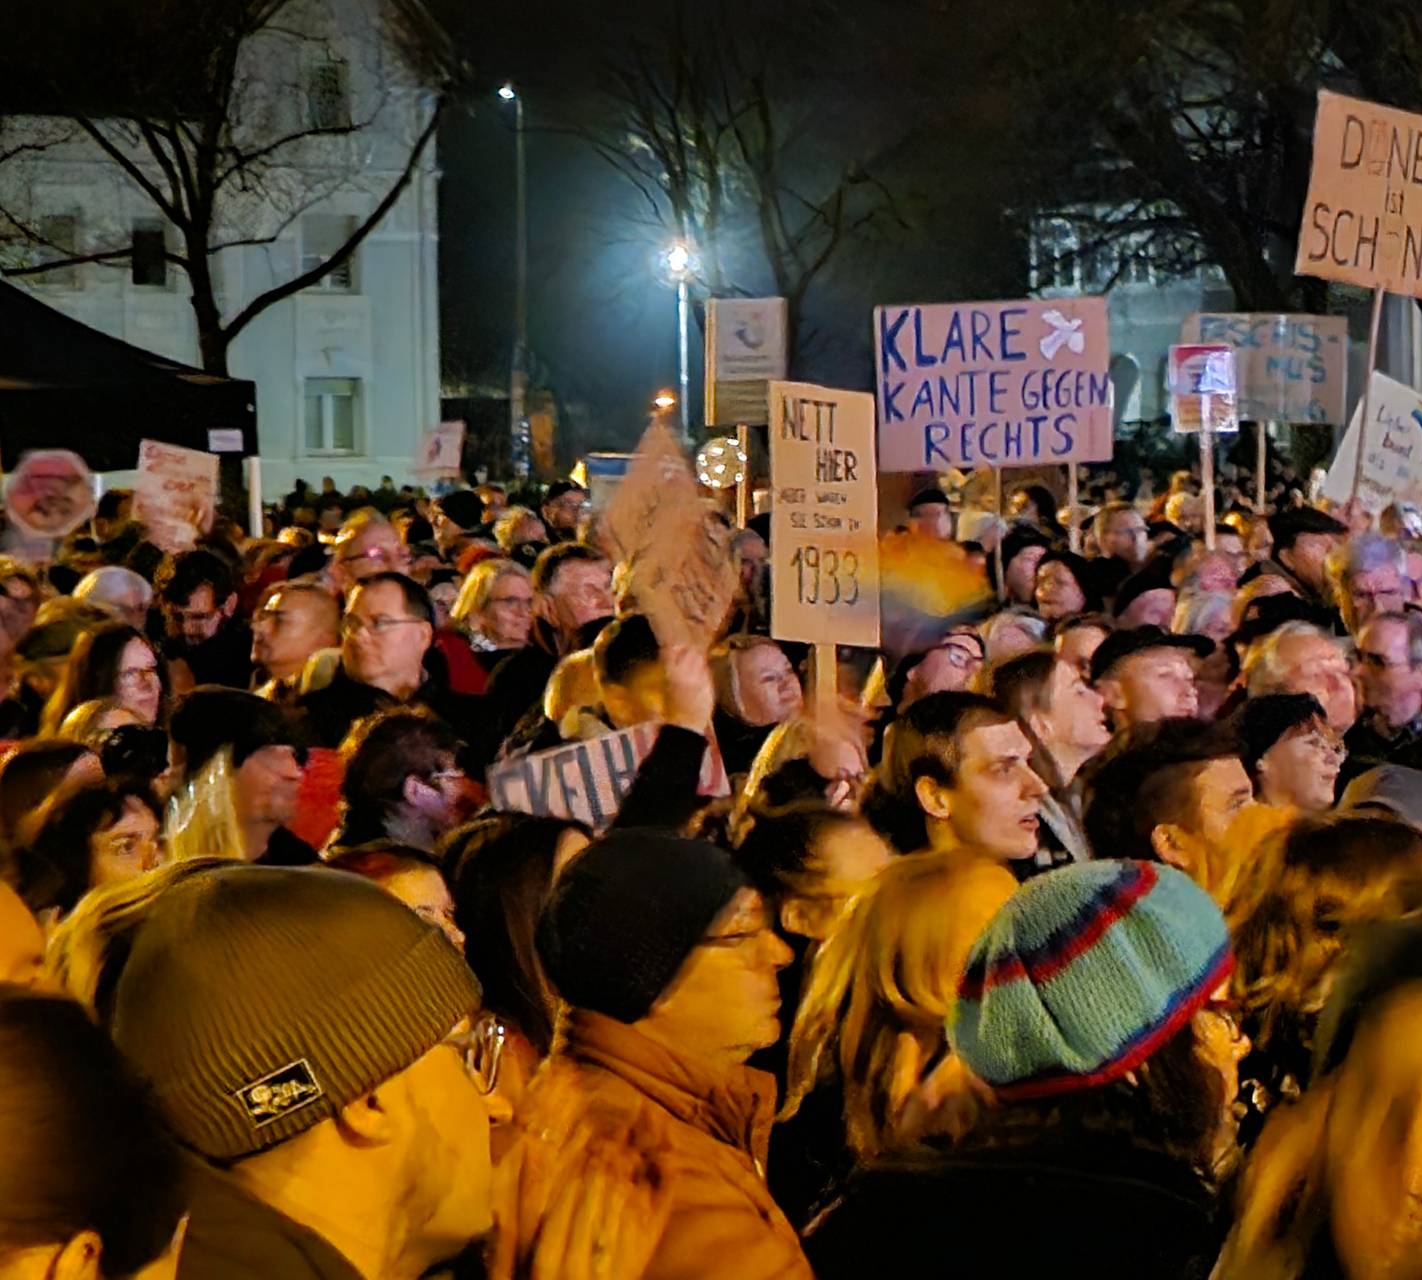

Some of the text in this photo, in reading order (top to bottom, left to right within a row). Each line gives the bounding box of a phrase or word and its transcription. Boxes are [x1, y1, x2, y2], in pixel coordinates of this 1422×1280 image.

[880, 308, 1028, 373] KLARE
[781, 393, 838, 444] NETT
[883, 368, 1109, 424] KANTE GEGEN
[815, 446, 859, 483] HIER
[924, 412, 1078, 466] RECHTS
[790, 545, 860, 606] 1933
